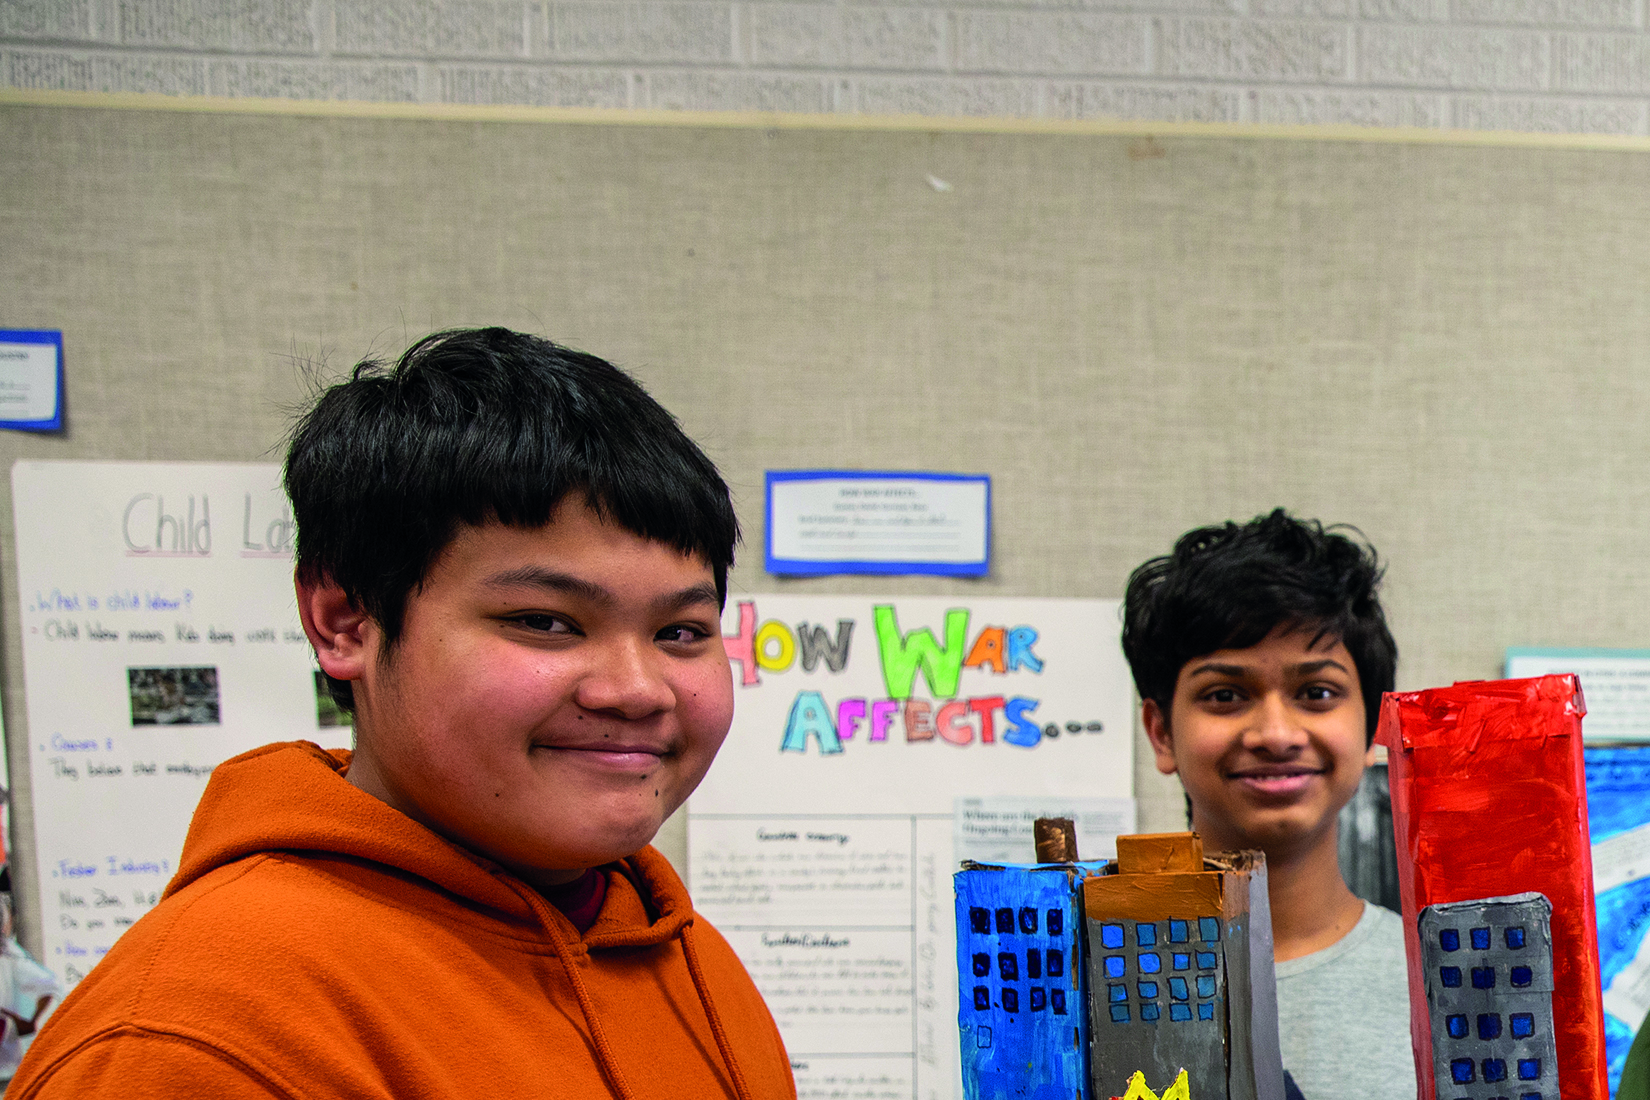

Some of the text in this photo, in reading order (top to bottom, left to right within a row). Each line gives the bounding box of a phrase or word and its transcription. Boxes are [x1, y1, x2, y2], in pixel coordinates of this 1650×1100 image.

[122, 493, 212, 554] Child
[723, 601, 1044, 700] HOW WAR
